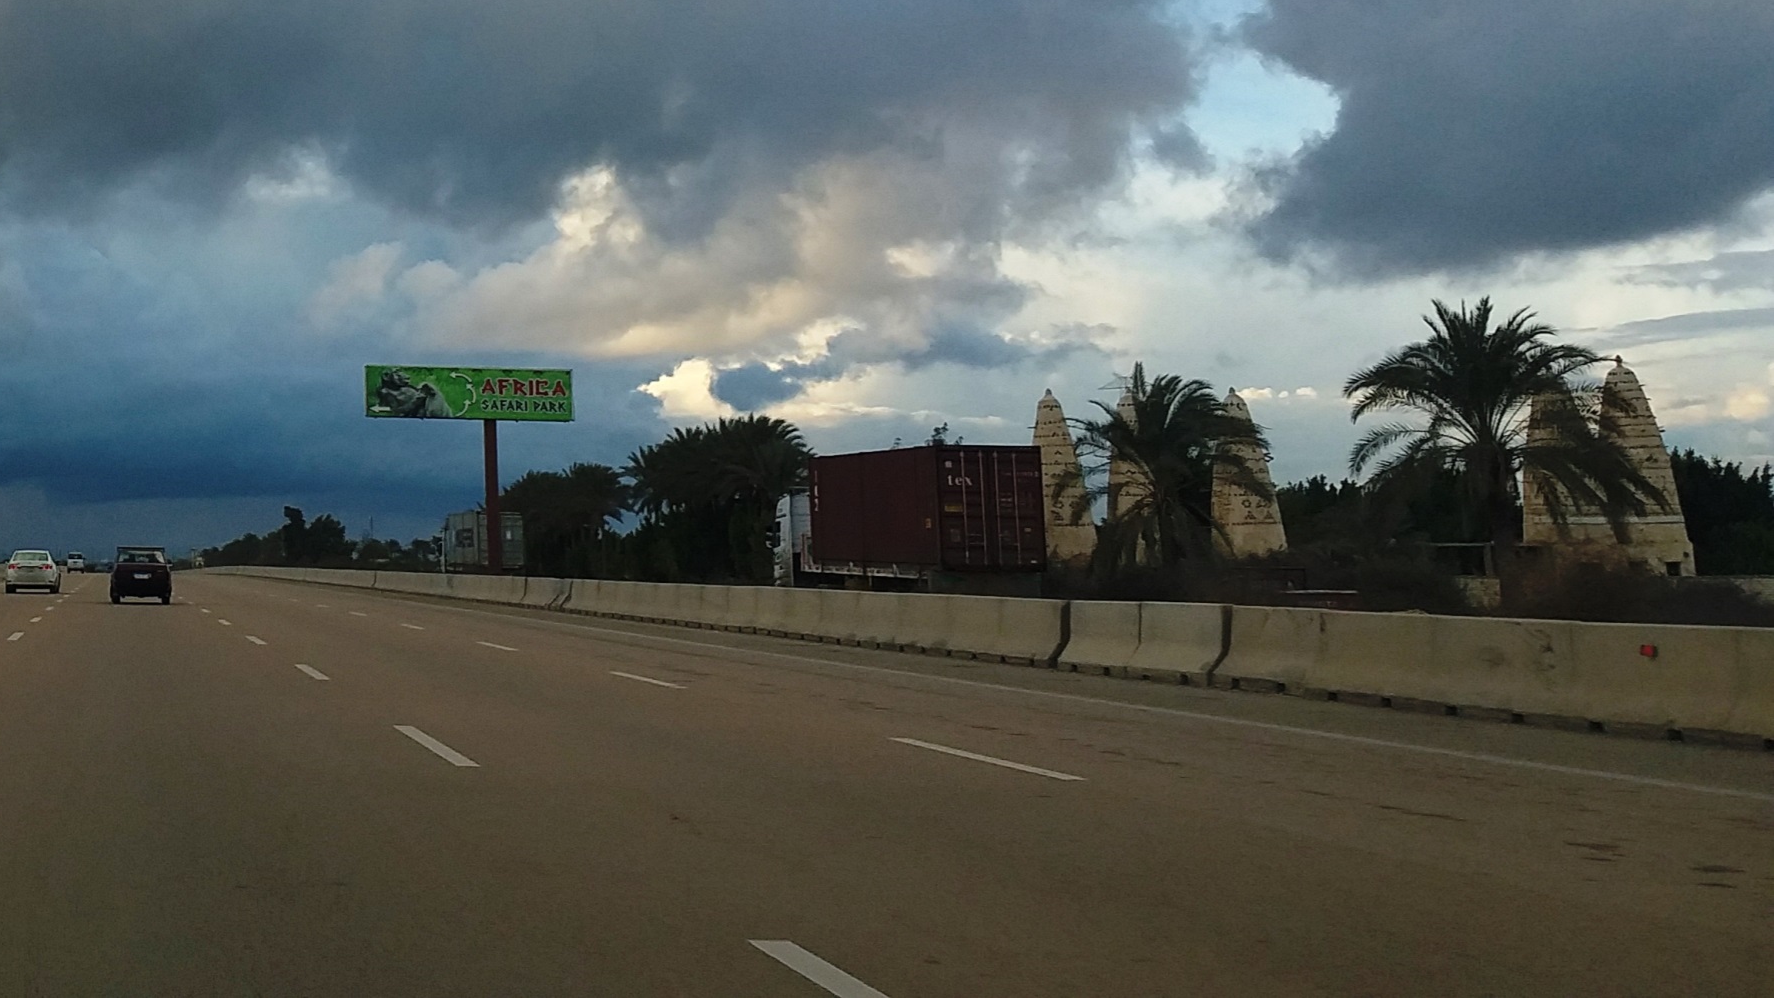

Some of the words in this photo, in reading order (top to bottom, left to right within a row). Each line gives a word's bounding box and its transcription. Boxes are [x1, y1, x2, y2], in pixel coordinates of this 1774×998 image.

[481, 378, 567, 396] AFRICA
[481, 399, 528, 412] SAFARI
[533, 400, 567, 413] PARK
[947, 474, 973, 486] tex
